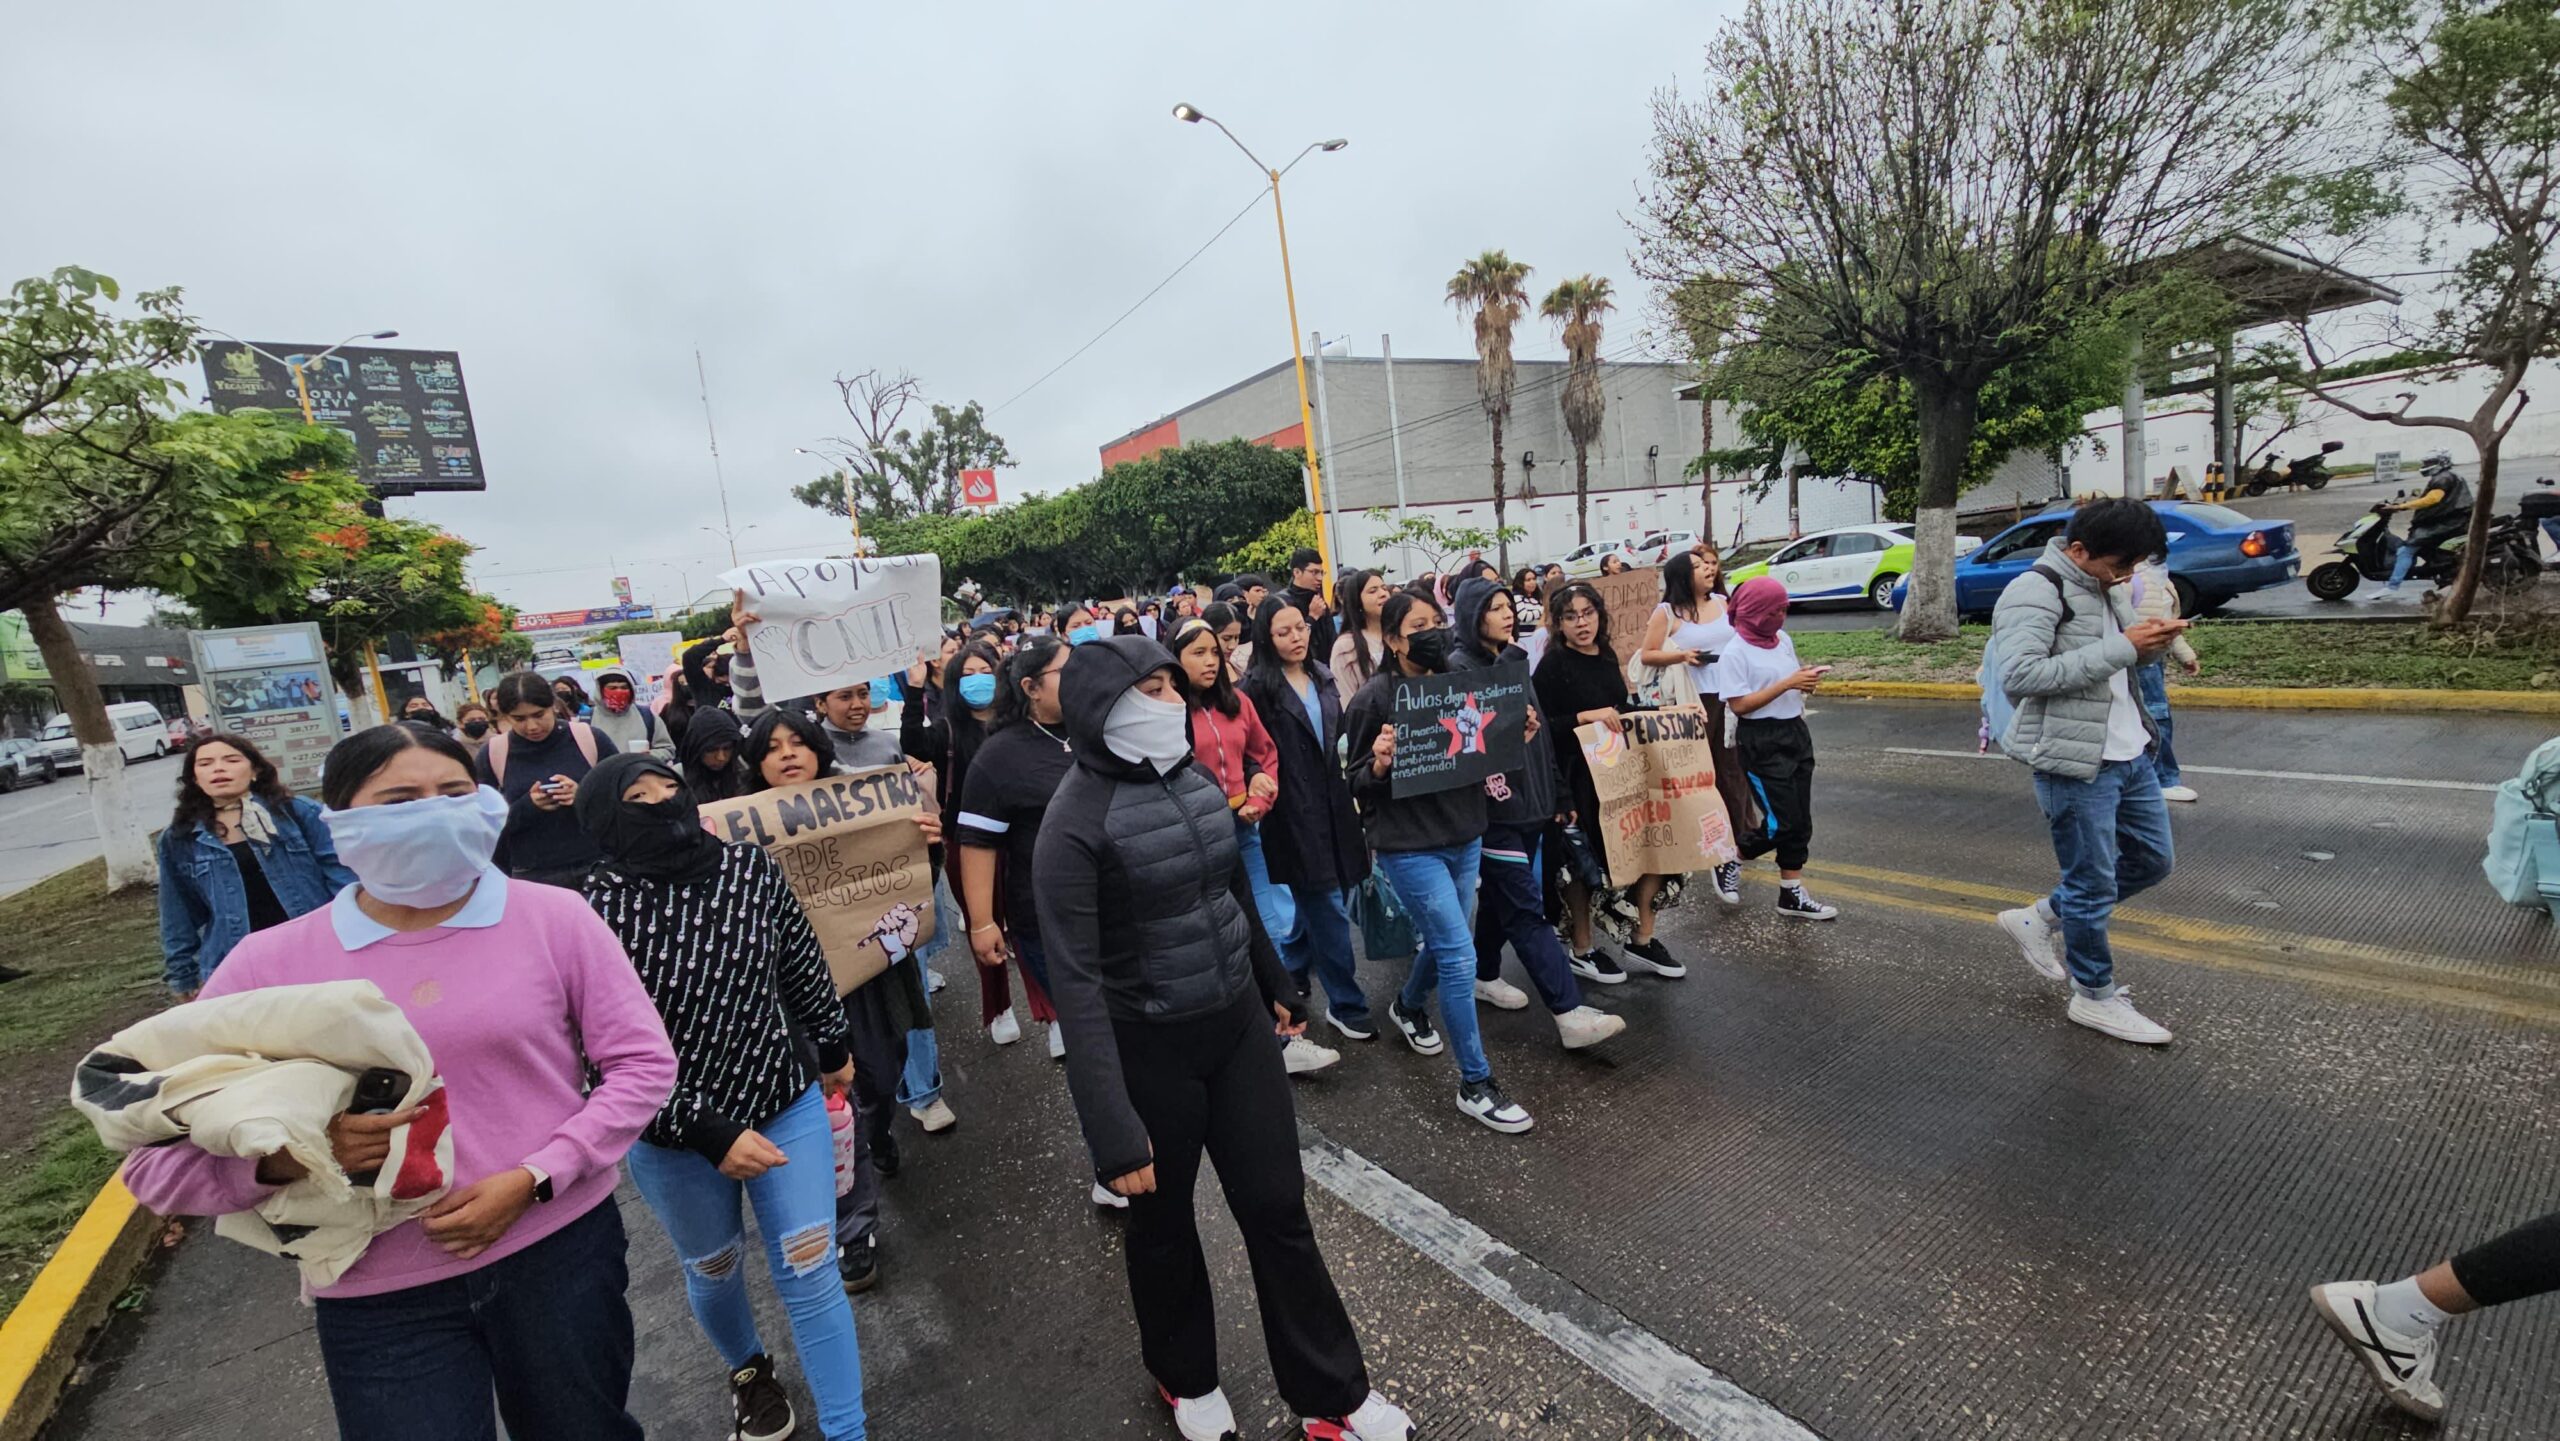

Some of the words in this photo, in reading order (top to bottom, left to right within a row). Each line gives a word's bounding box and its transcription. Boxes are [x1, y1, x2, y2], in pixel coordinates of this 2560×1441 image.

[286, 389, 358, 400] GORIA
[1594, 582, 1658, 610] EDIMOS
[518, 616, 551, 627] 50%
[1395, 683, 1442, 712] Aulas
[1622, 712, 1705, 750] PENSIONES
[725, 806, 776, 846] EL
[773, 836, 843, 876] IDE
